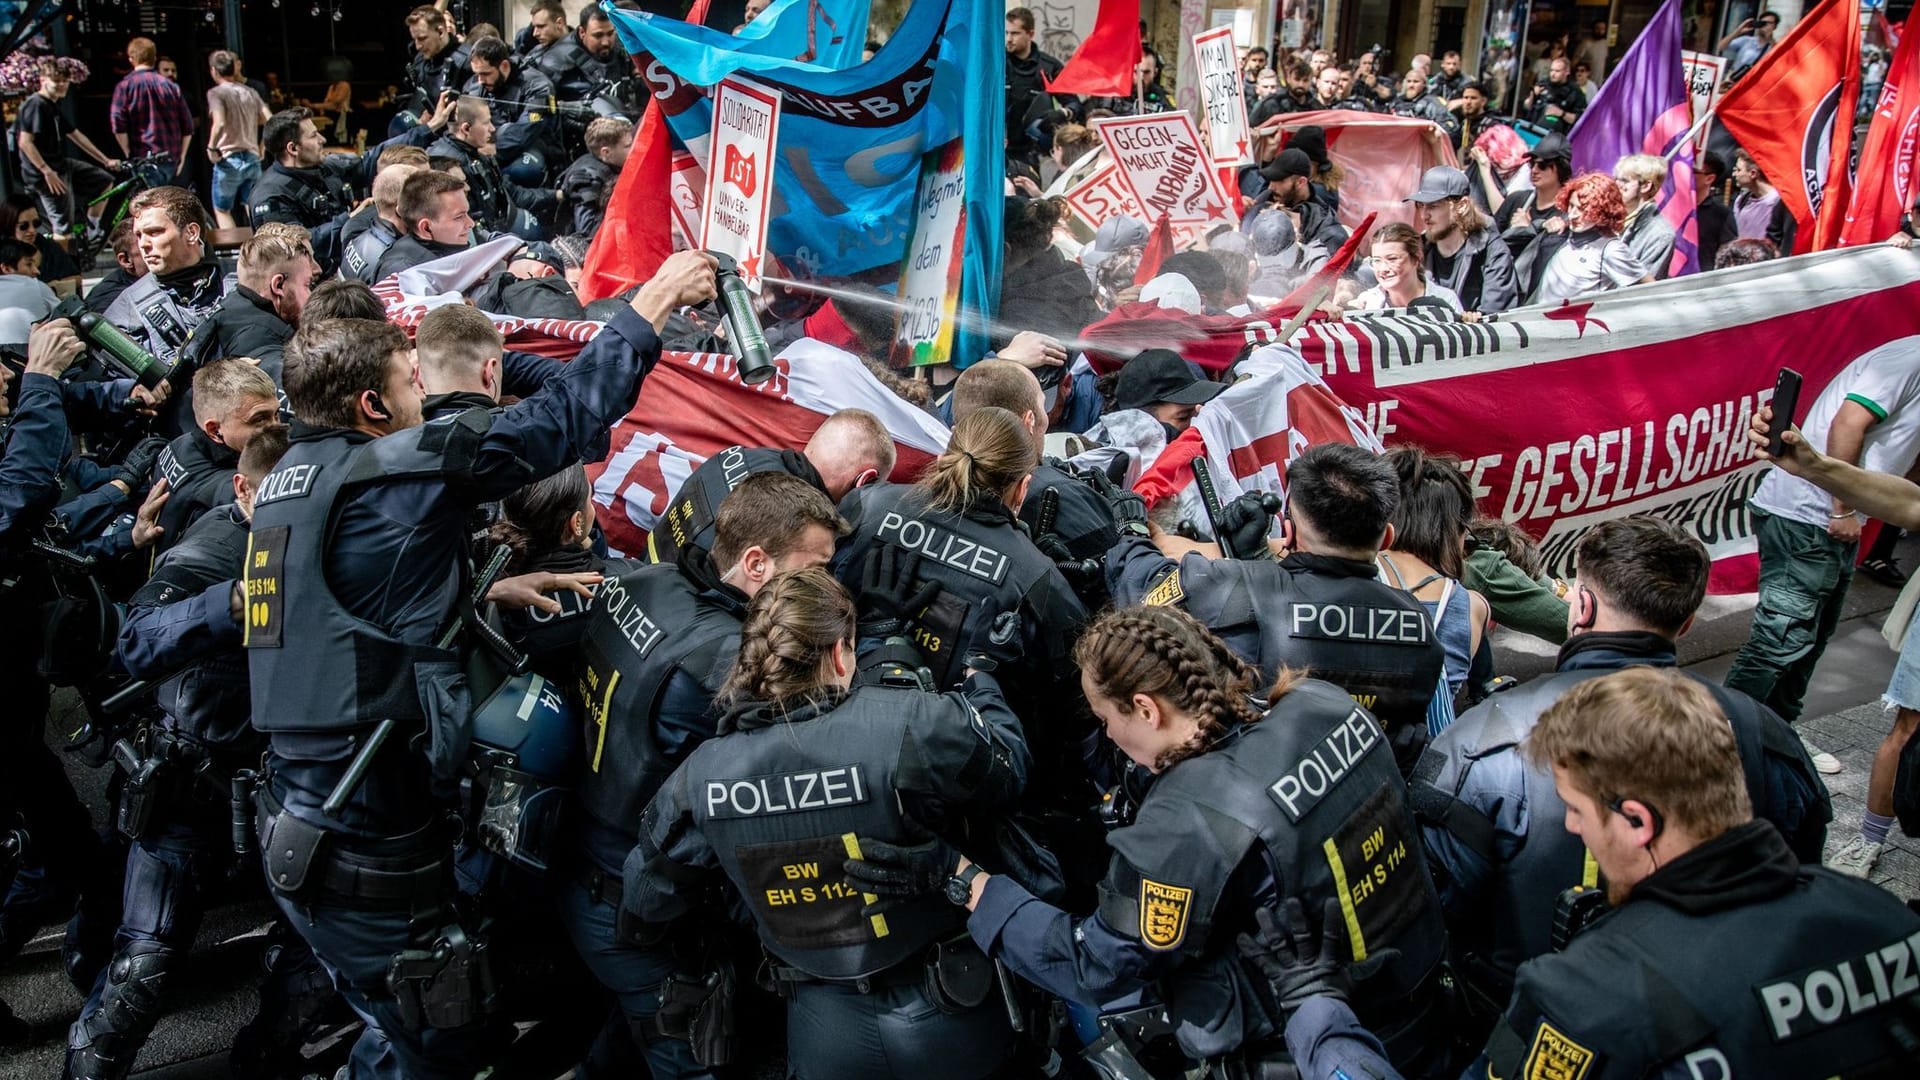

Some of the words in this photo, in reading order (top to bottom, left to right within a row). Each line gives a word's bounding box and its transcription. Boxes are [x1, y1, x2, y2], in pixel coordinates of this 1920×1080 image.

[1114, 126, 1178, 151] GEGEN-
[1123, 152, 1170, 172] MACHT
[915, 232, 942, 271] dem
[1502, 386, 1778, 526] GESELLSCHAF
[254, 464, 317, 505] POLIZEI
[255, 550, 270, 568] BW
[876, 511, 1007, 581] POLIZEI
[600, 575, 662, 655] POLIZEI
[1292, 603, 1427, 643] POLIZEI
[914, 627, 941, 652] 113
[1271, 707, 1380, 818] POLIZEI
[706, 766, 864, 818] POLIZEI
[1361, 826, 1386, 862] BW
[782, 862, 819, 881] BW
[1352, 875, 1375, 907] EH
[1374, 863, 1387, 885] S
[766, 889, 798, 907] EH
[801, 886, 817, 903] S
[1146, 884, 1186, 902] POLIZEI
[1542, 1030, 1584, 1065] POLIZEI
